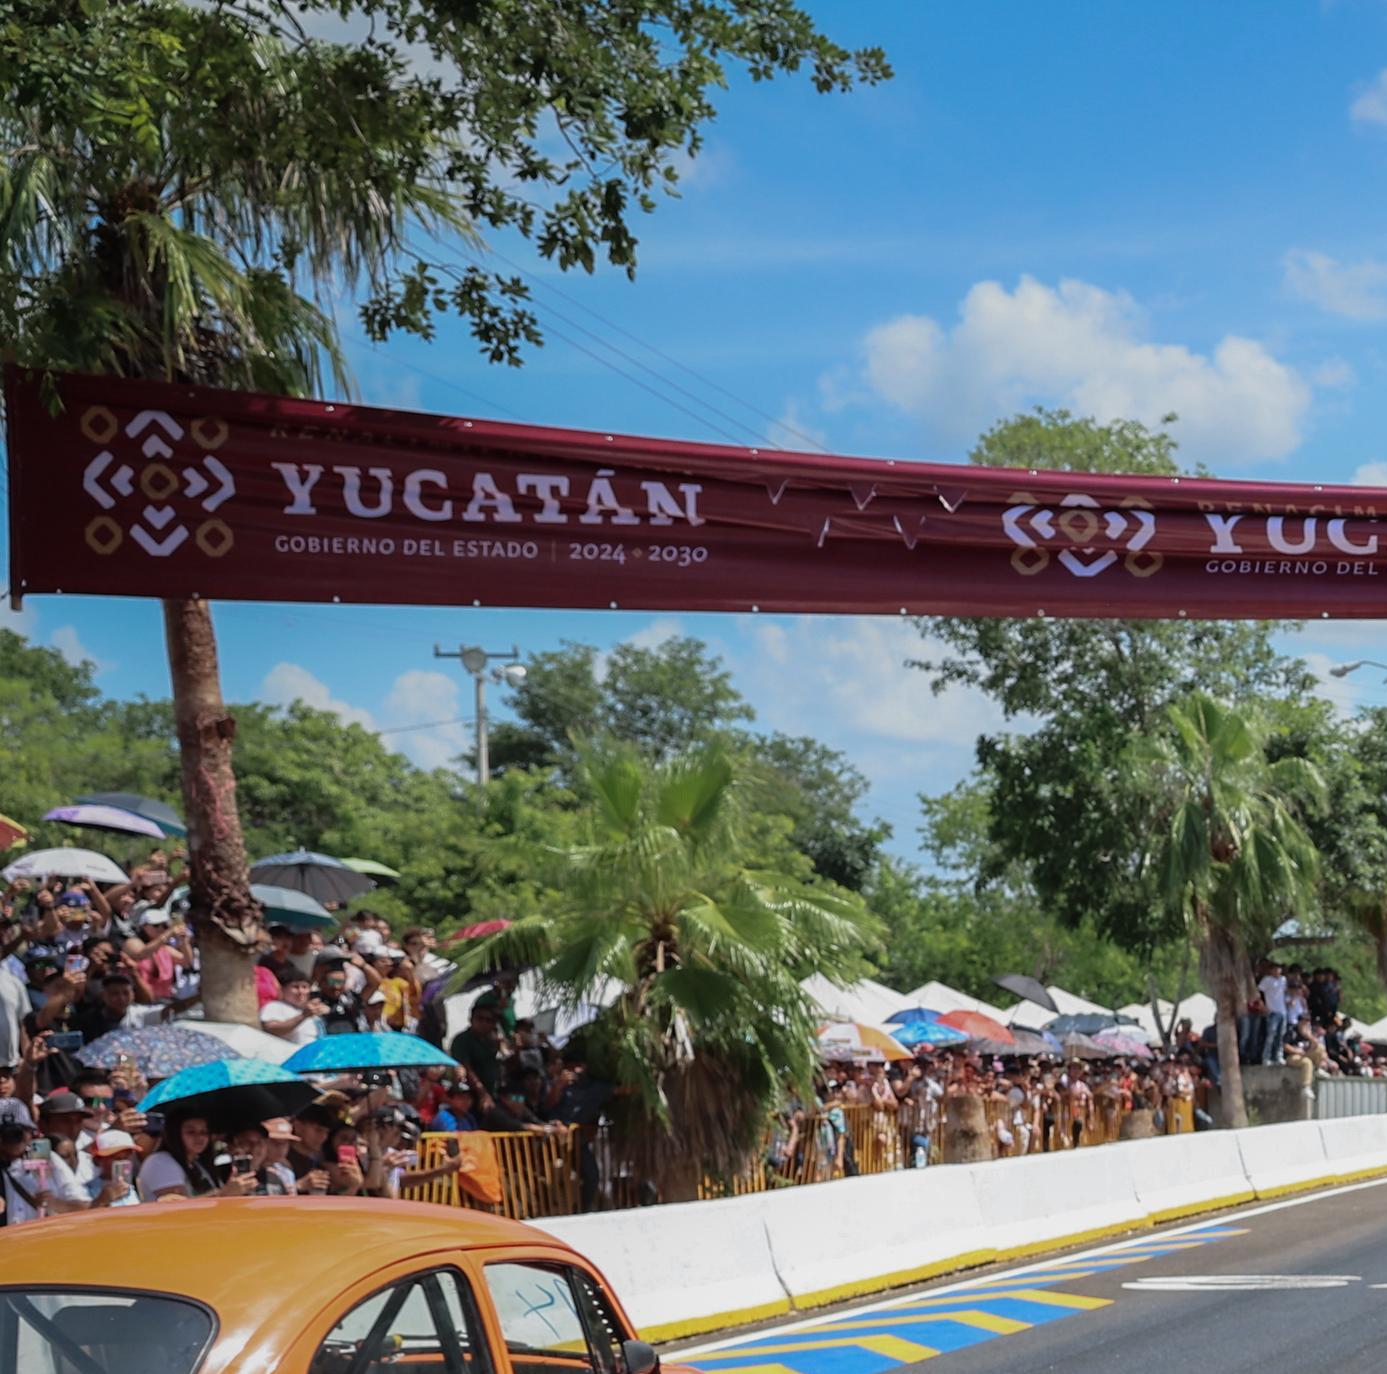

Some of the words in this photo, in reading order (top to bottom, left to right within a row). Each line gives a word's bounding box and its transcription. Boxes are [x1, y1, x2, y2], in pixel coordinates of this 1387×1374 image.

[270, 461, 706, 527] YUCATÁN
[274, 535, 396, 555] GOBIERNO
[403, 539, 446, 556] DEL
[453, 540, 539, 559] ESTADO
[569, 543, 627, 564] 2024
[648, 545, 708, 567] 2030
[1205, 560, 1328, 575] GOBIERNO
[1336, 561, 1379, 575] DEL
